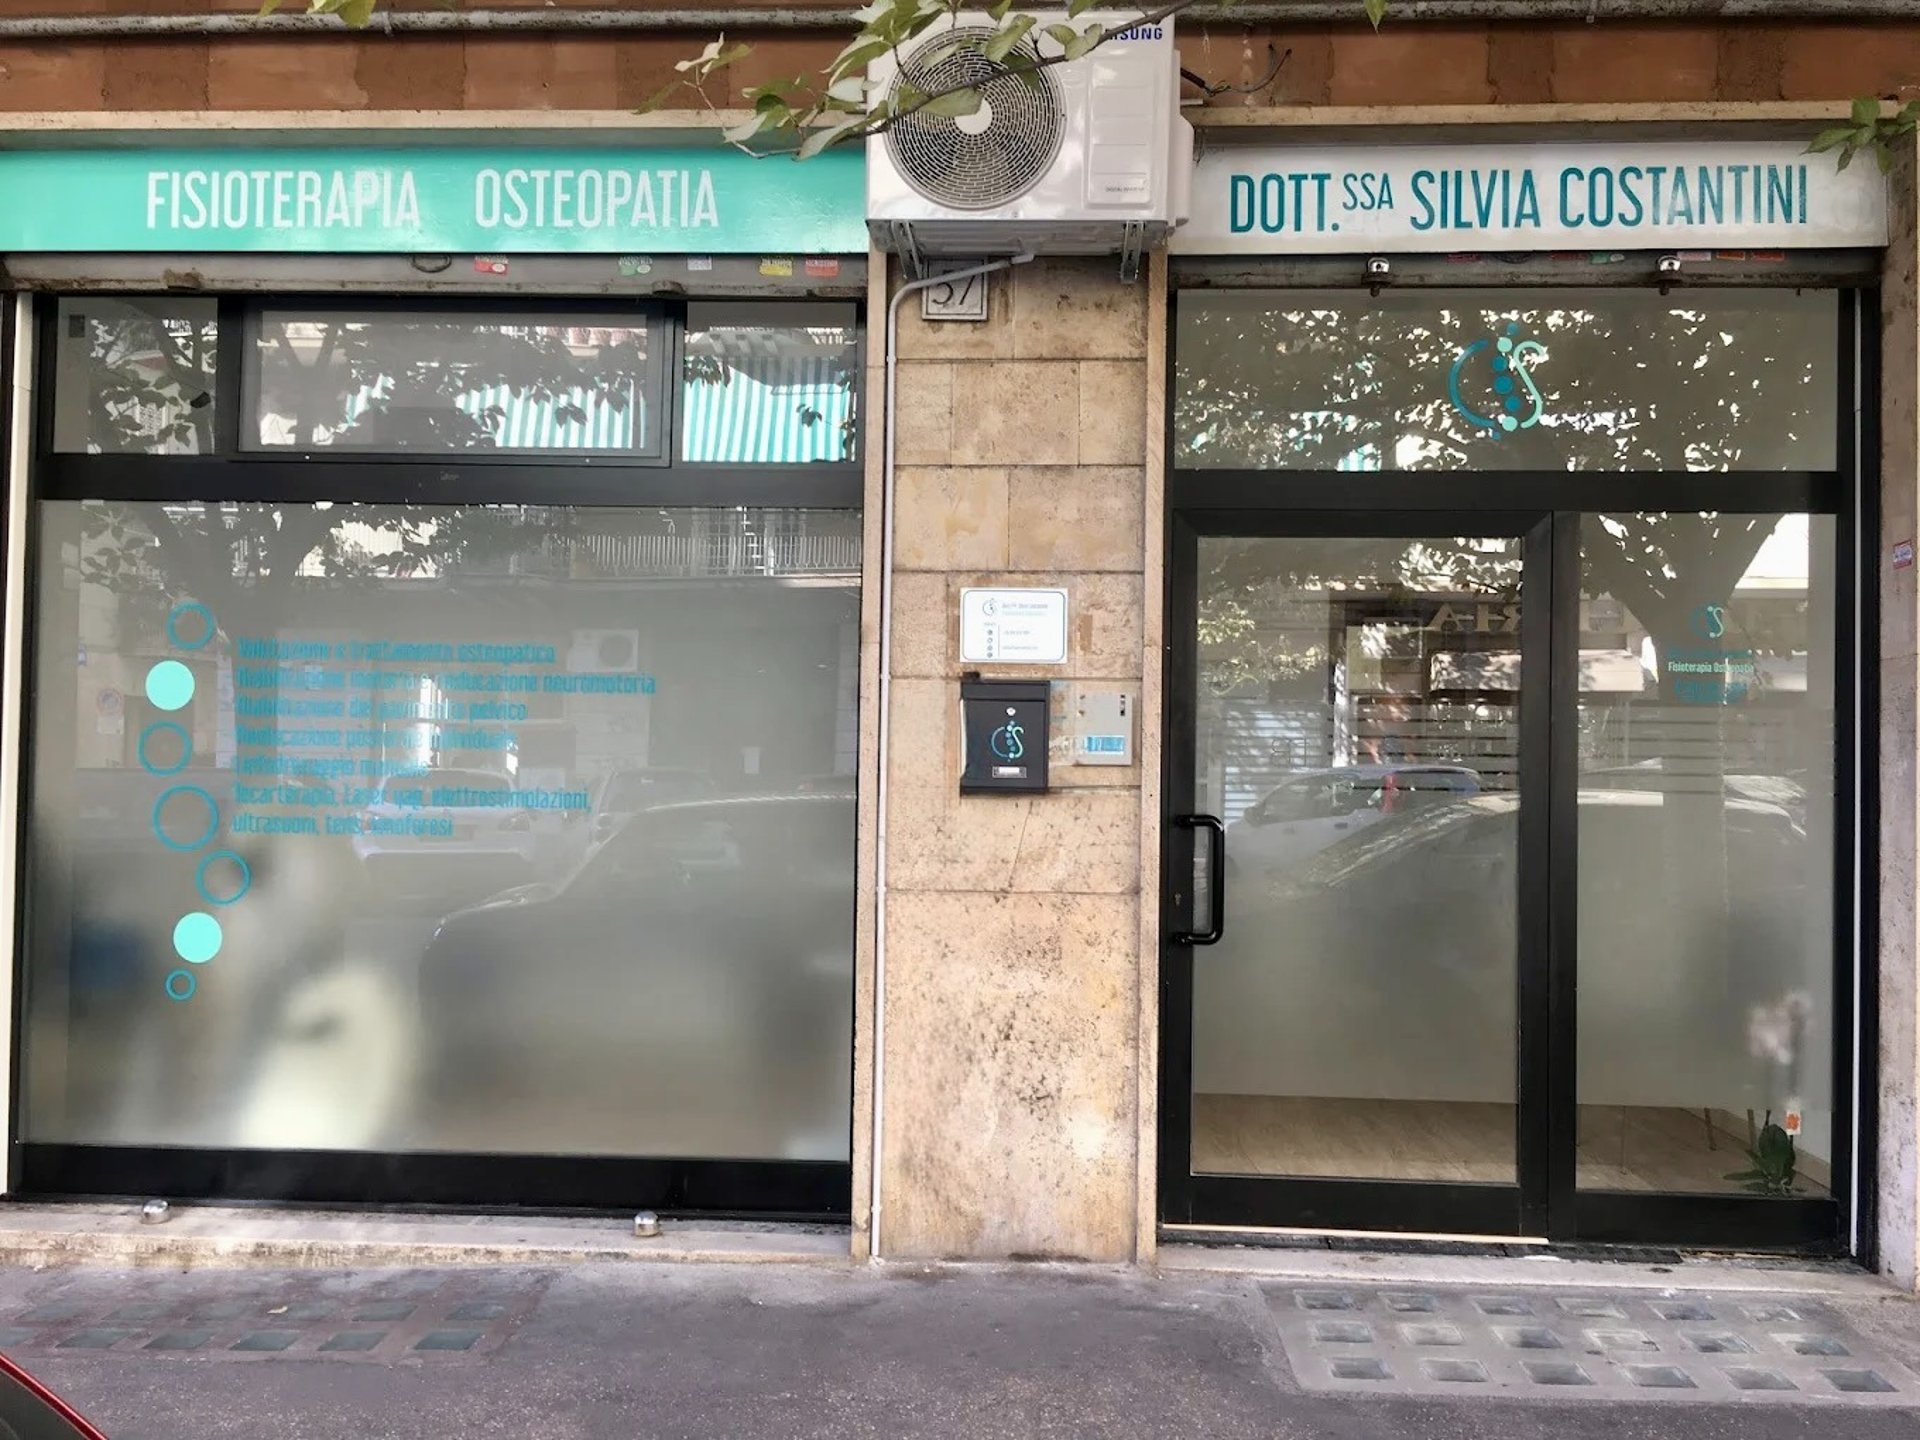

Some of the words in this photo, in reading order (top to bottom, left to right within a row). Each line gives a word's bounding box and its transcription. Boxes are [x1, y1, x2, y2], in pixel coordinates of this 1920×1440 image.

[146, 170, 421, 229] FISIOTERAPIA
[475, 168, 719, 228] OSTEOPATIA
[1410, 169, 1541, 230] SILVIA
[1559, 164, 1807, 228] COSTANTINI
[543, 673, 657, 694] neuromotoria
[469, 702, 528, 722] pelvico
